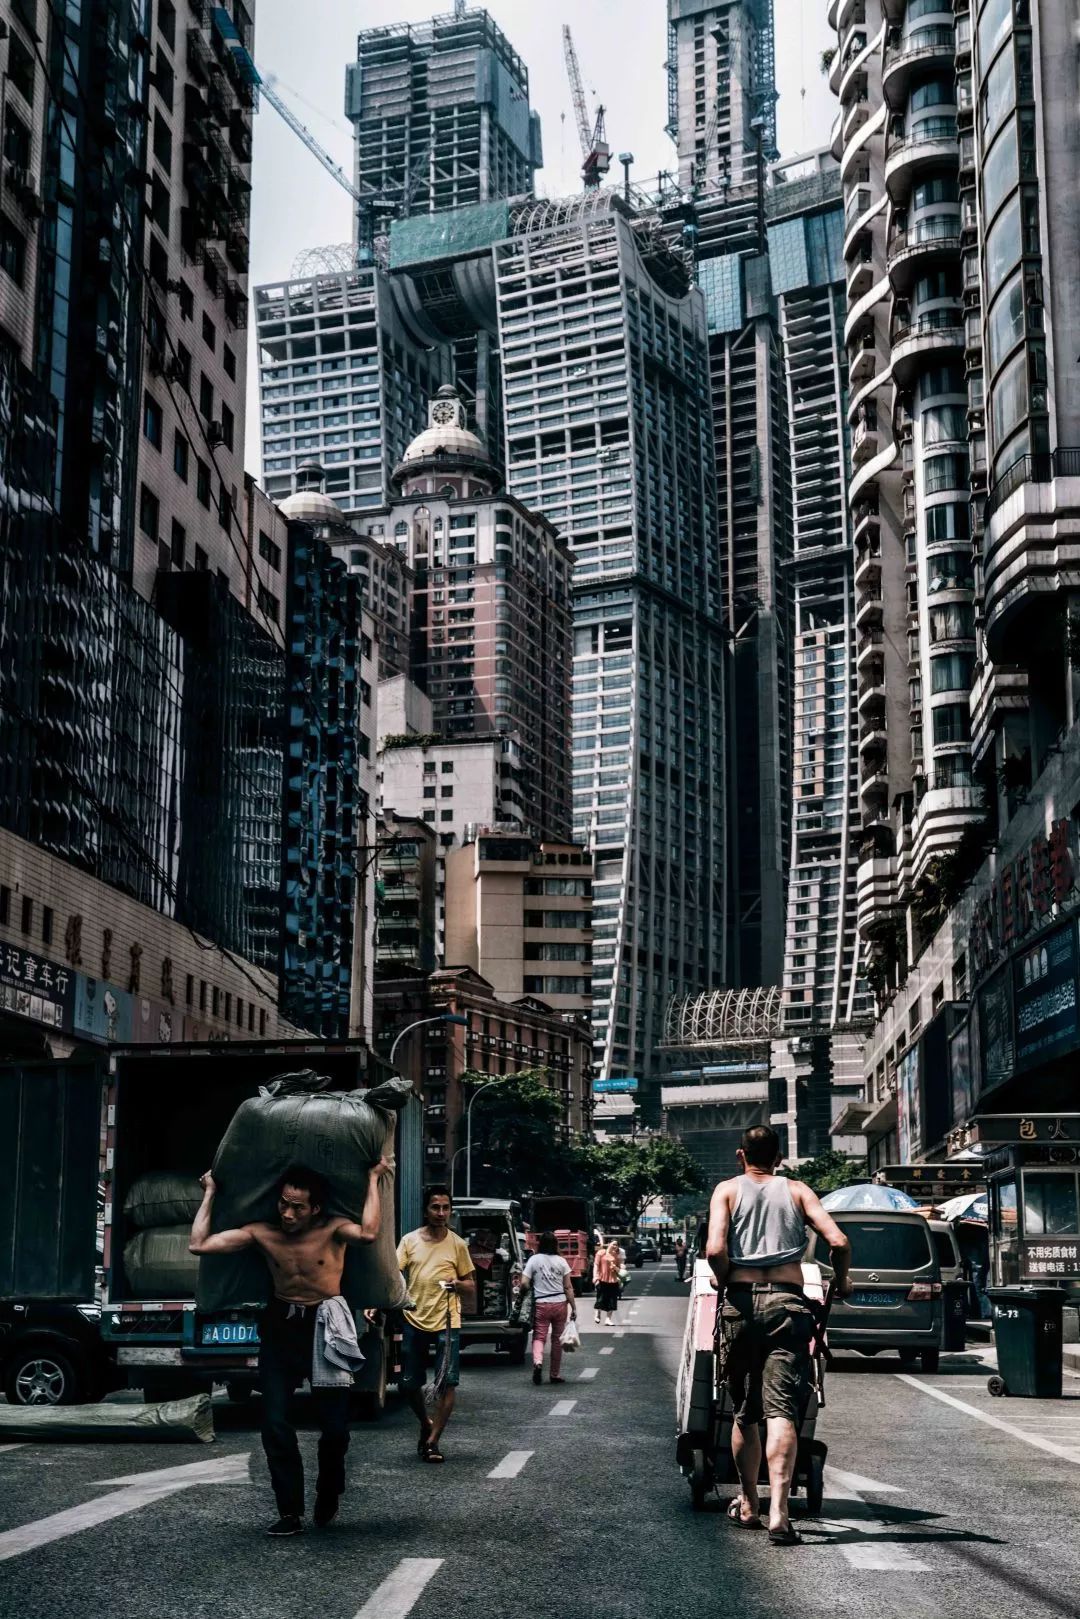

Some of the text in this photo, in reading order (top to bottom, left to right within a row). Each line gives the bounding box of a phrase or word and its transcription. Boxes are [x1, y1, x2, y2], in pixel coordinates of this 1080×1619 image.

[1027, 1246, 1078, 1259] 不用劣质食材
